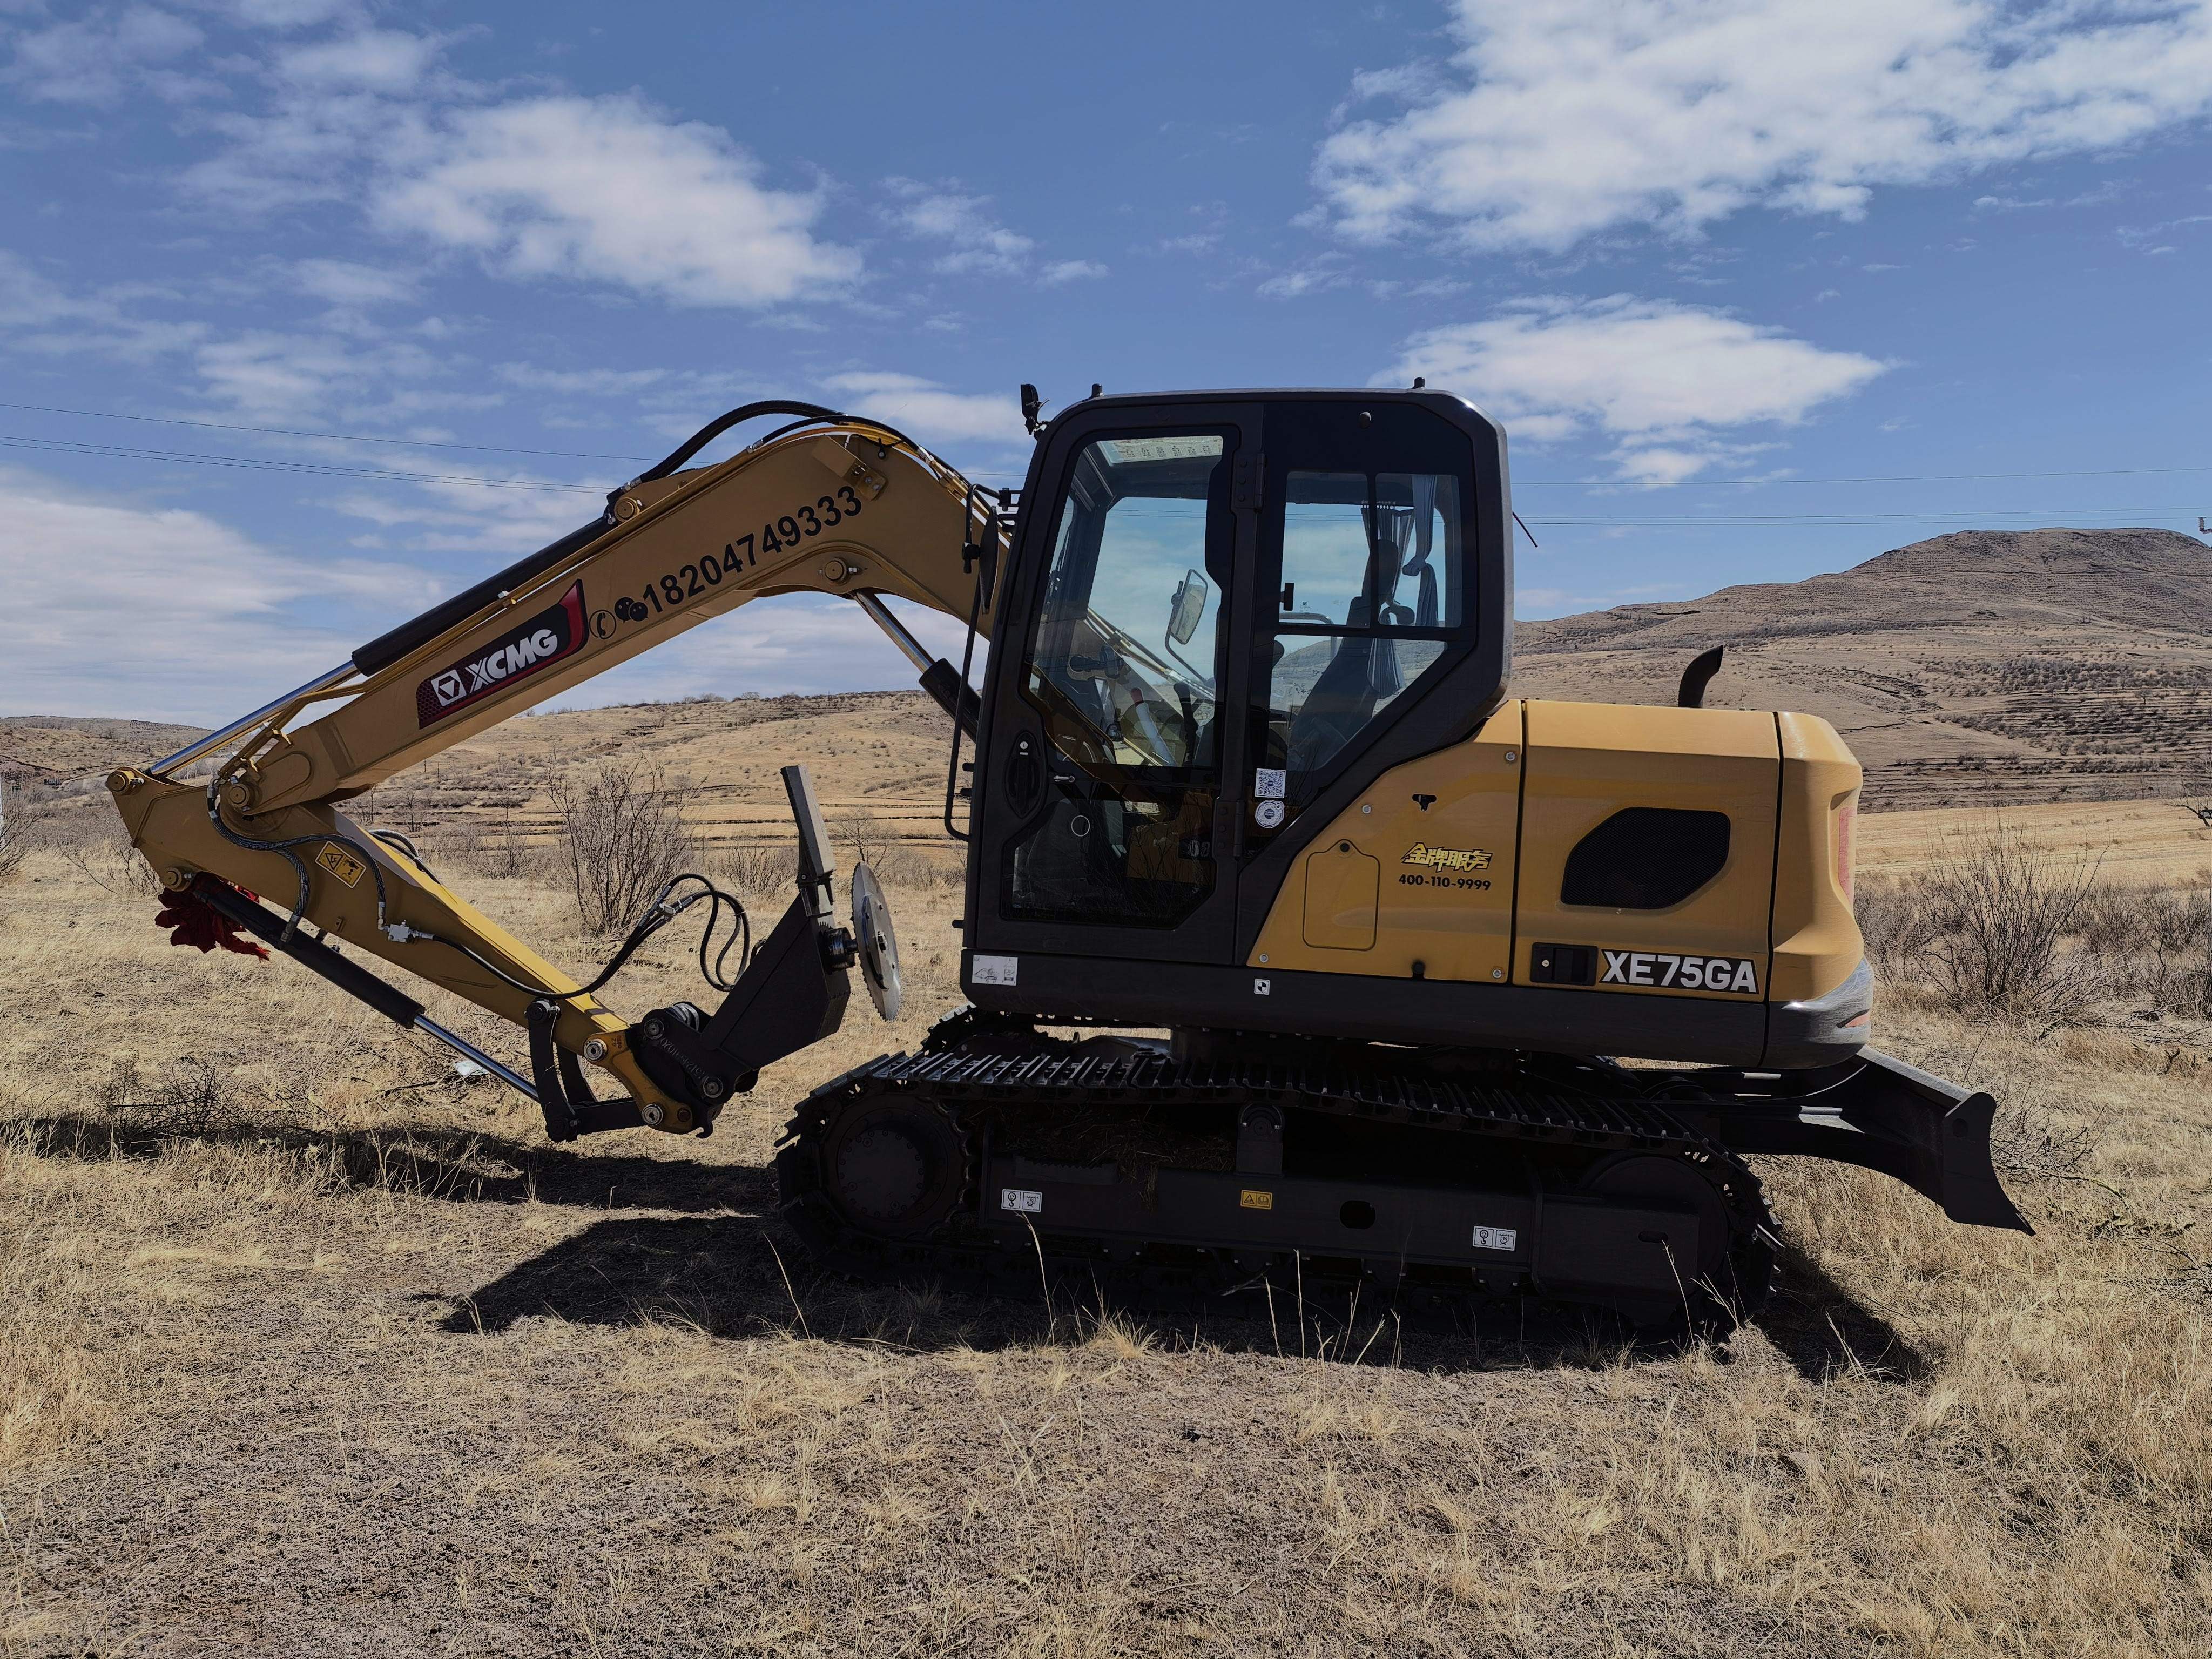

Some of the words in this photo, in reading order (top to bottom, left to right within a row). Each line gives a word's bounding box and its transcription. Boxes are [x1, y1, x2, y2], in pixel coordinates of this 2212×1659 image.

[643, 485, 862, 613] 18204749333
[465, 629, 558, 694] XCMG
[1400, 842, 1493, 873] 金牌服务
[1398, 874, 1491, 891] 400-110-9999
[1602, 951, 1757, 993] XE75GA
